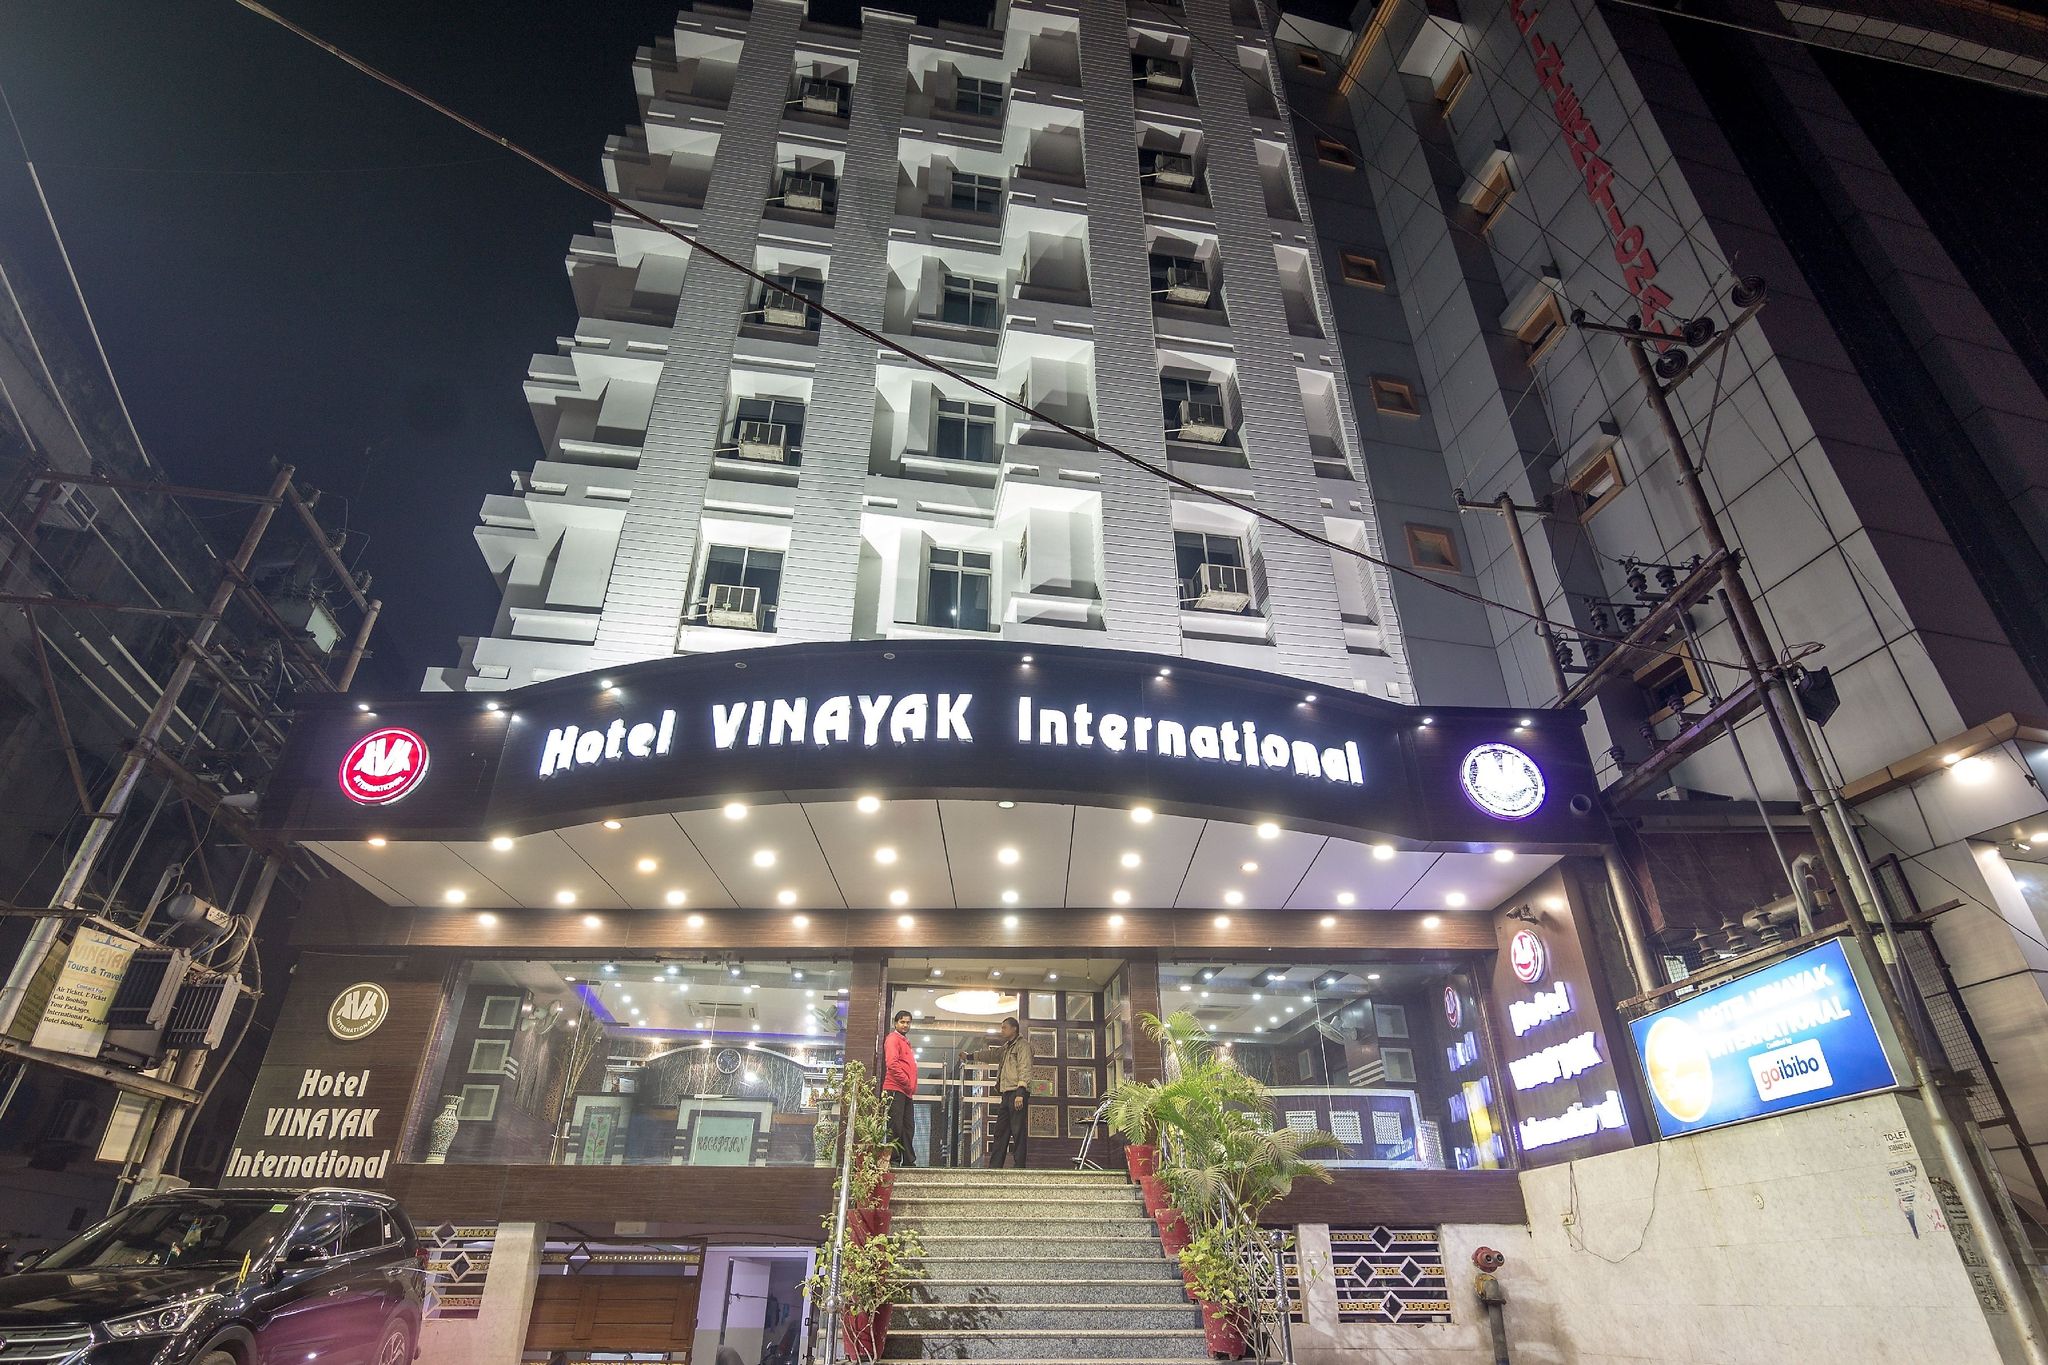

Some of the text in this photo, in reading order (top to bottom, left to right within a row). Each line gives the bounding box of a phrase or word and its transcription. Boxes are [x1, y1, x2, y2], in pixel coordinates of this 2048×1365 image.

[539, 692, 1364, 786] Hotel VINAYAK International
[67, 960, 88, 973] Tours
[90, 966, 97, 974] &
[66, 996, 88, 1007] Booking
[43, 1016, 59, 1024] Hotel
[47, 1008, 83, 1021] International
[335, 1016, 375, 1033] INTERNATIONAL
[1760, 1055, 1820, 1090] goibibo
[297, 1069, 370, 1100] Hotel
[264, 1107, 381, 1141] VINAYAK
[696, 1135, 748, 1153] RECEPTION
[1883, 1130, 1908, 1142] TO-LET
[225, 1147, 391, 1179] International
